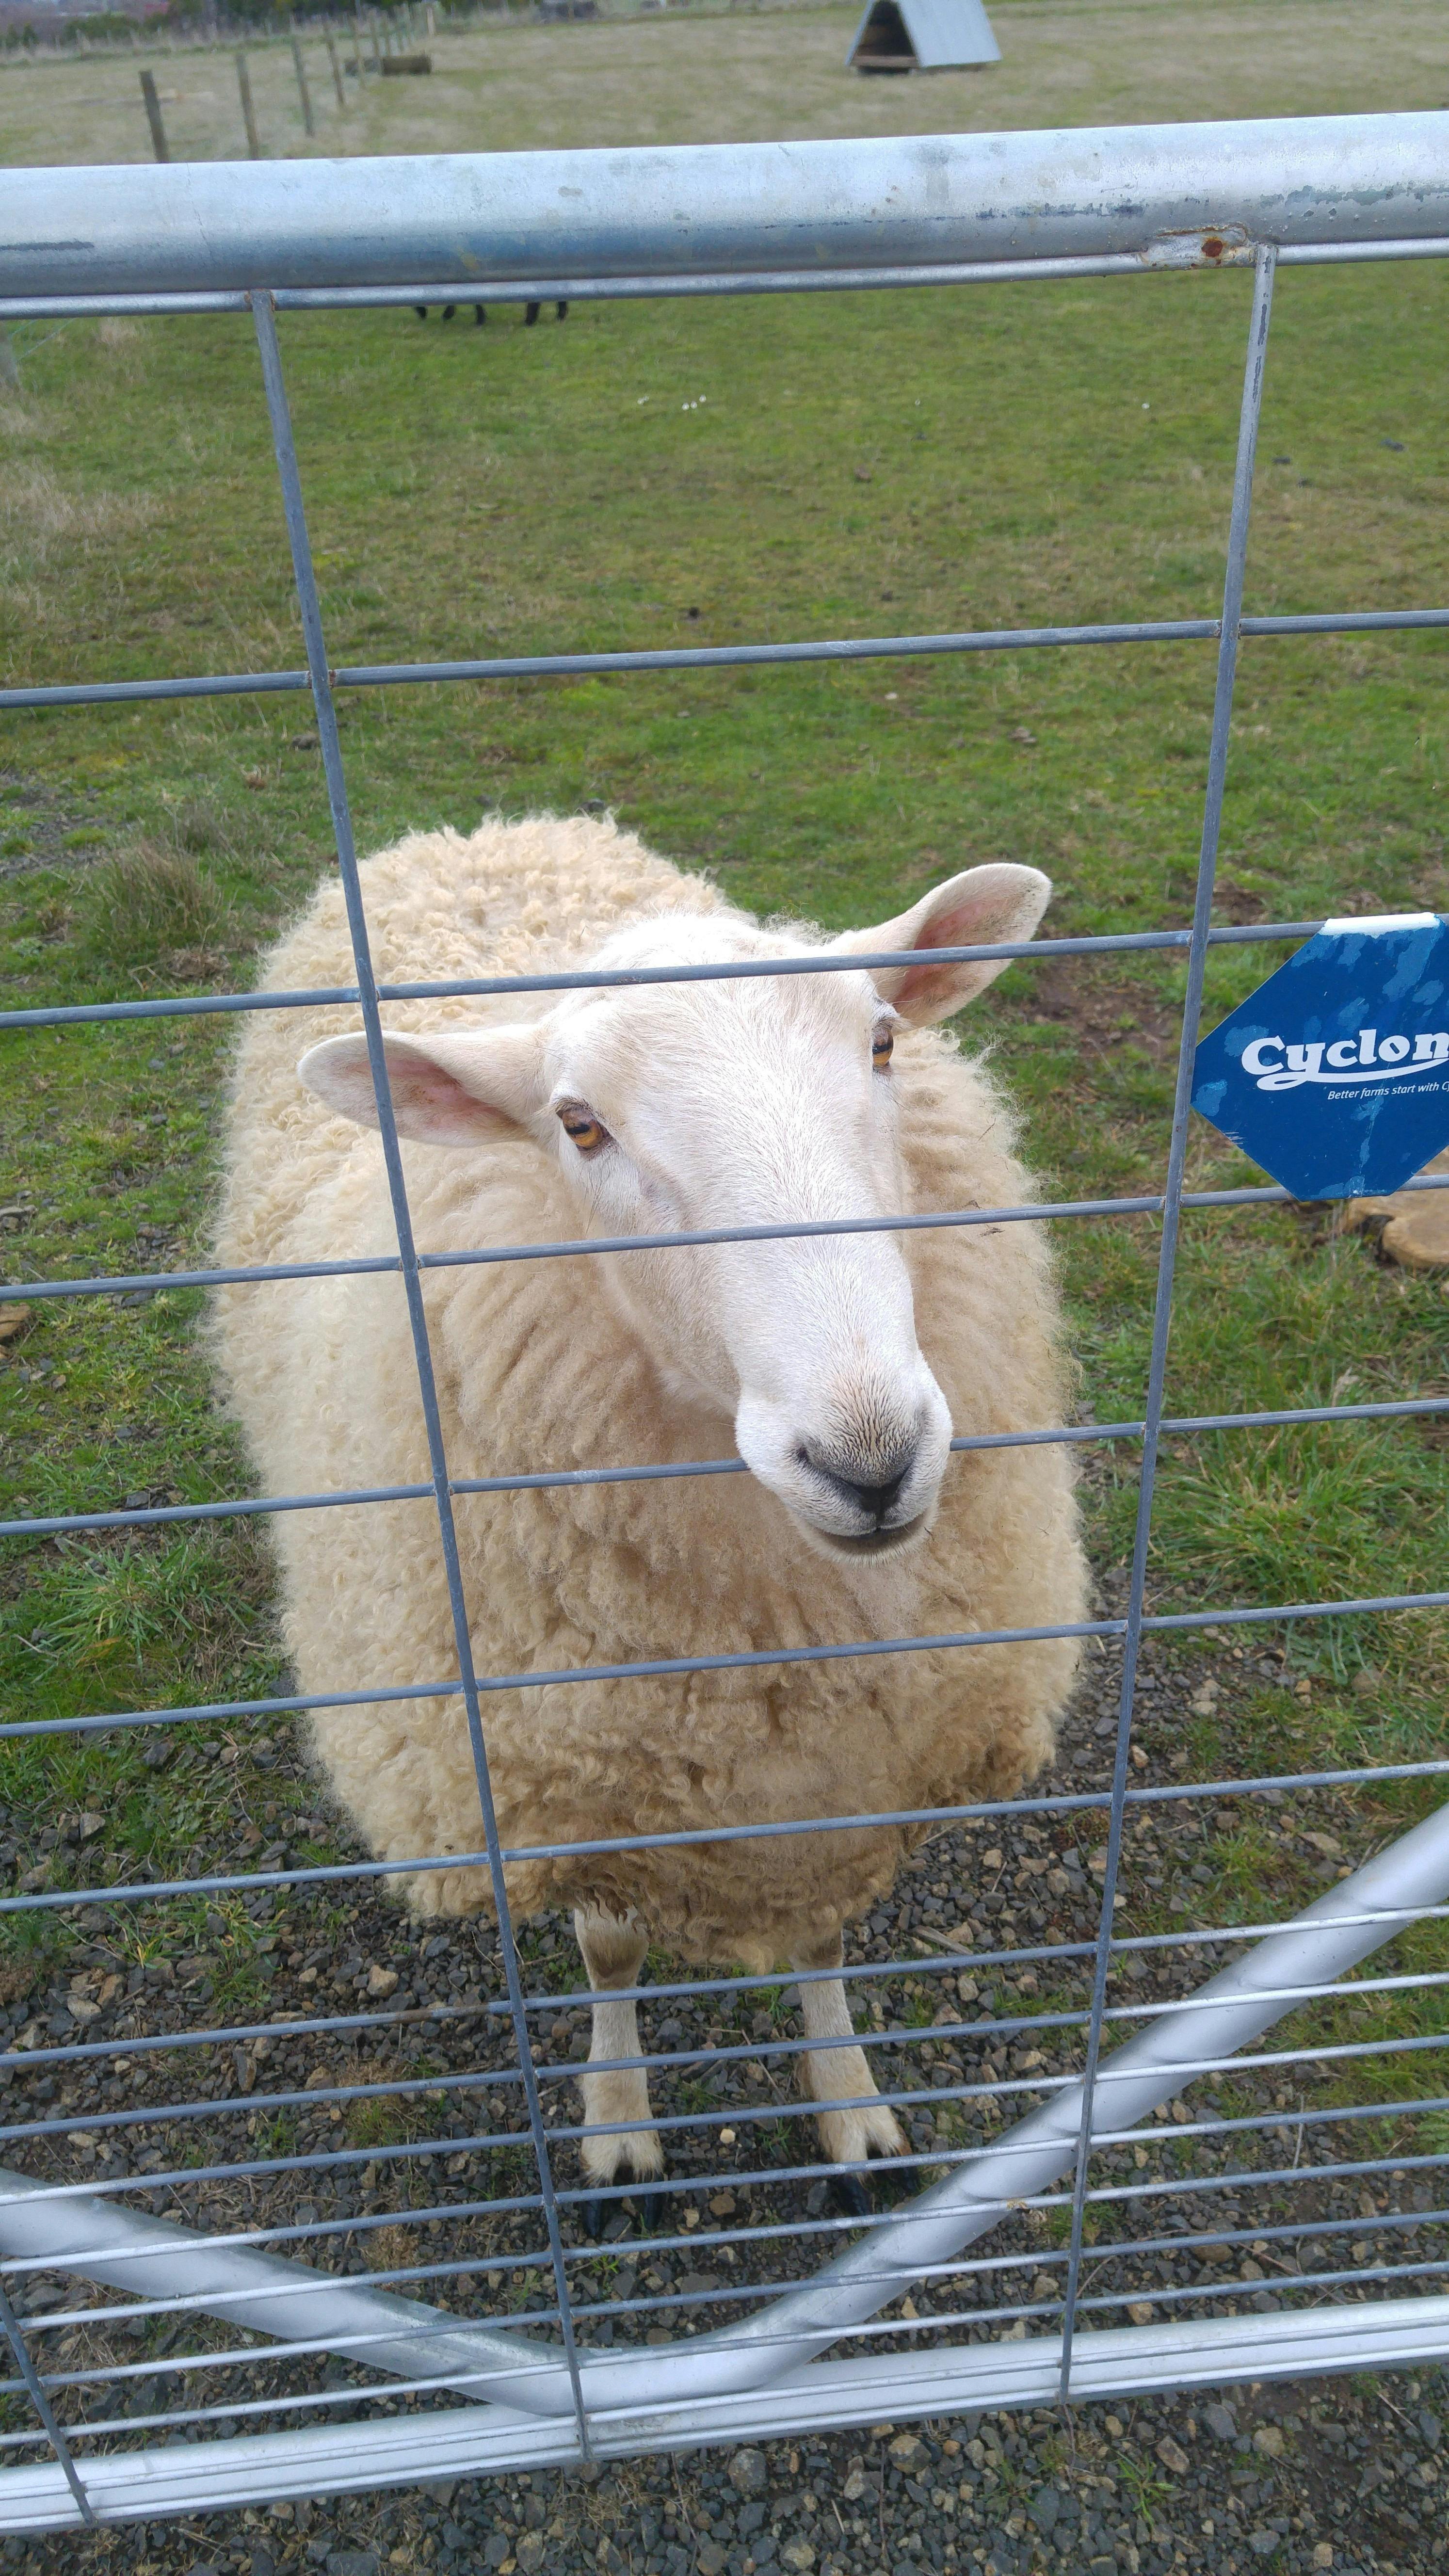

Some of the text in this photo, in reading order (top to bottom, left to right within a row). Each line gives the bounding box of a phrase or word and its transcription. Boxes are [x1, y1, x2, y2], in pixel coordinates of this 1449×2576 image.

[1327, 1090, 1360, 1100] Better
[1360, 1087, 1390, 1099] farms
[1391, 1084, 1416, 1095] start
[1417, 1081, 1440, 1092] with
